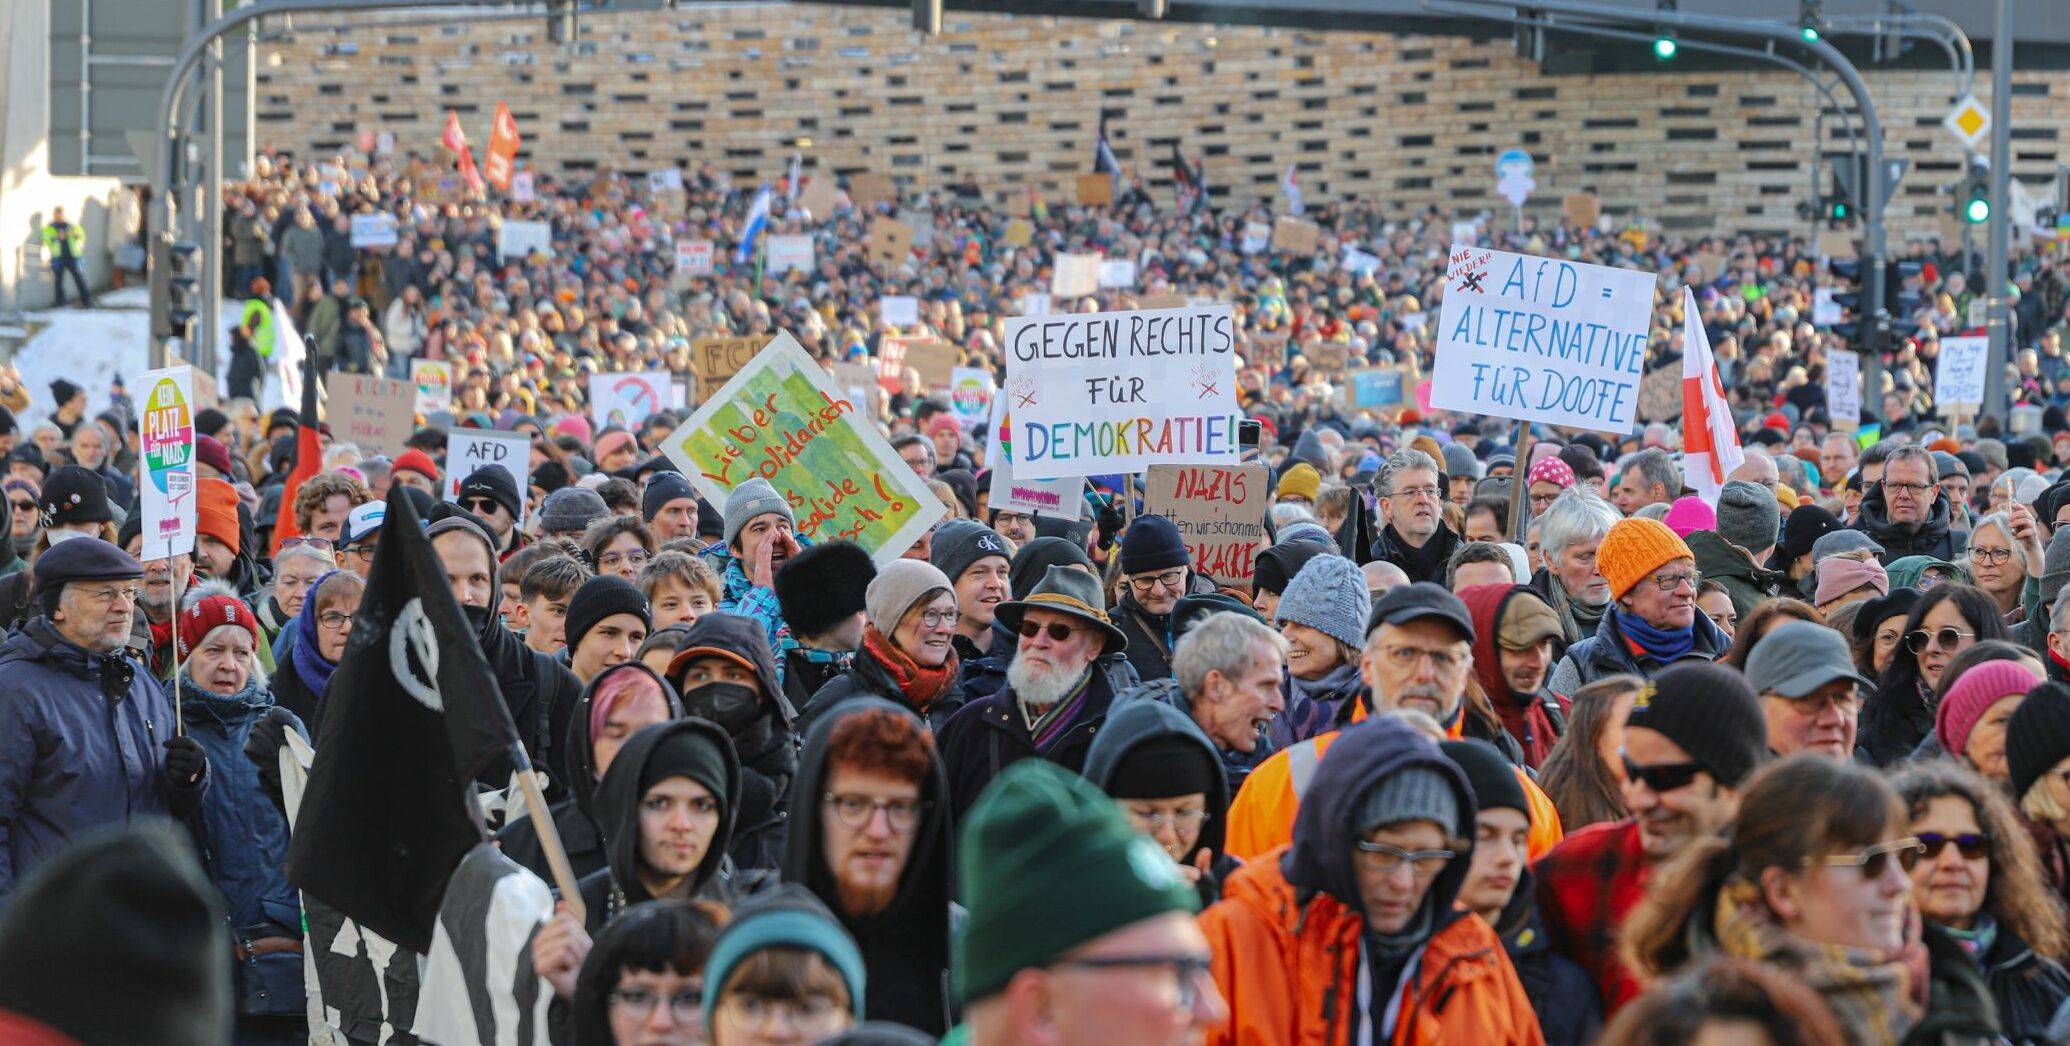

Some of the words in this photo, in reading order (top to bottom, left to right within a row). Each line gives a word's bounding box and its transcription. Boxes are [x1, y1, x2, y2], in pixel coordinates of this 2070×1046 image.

[1452, 249, 1470, 265] NIE
[1501, 256, 1578, 308] AfD
[1014, 318, 1119, 362] GEGEN
[1130, 314, 1231, 356] RECHTS
[1452, 304, 1647, 374] ALTERNATIVE
[1086, 375, 1148, 405] FÜR
[1471, 363, 1531, 409] FÜR
[1535, 369, 1632, 423] DOOFE
[149, 408, 180, 441] PLATZ
[702, 392, 778, 486] Lieber
[1025, 415, 1235, 462] DEMOKRATIE!
[163, 440, 185, 466] NAZIS
[466, 441, 508, 461] AFD
[1174, 468, 1247, 505] NAZIS
